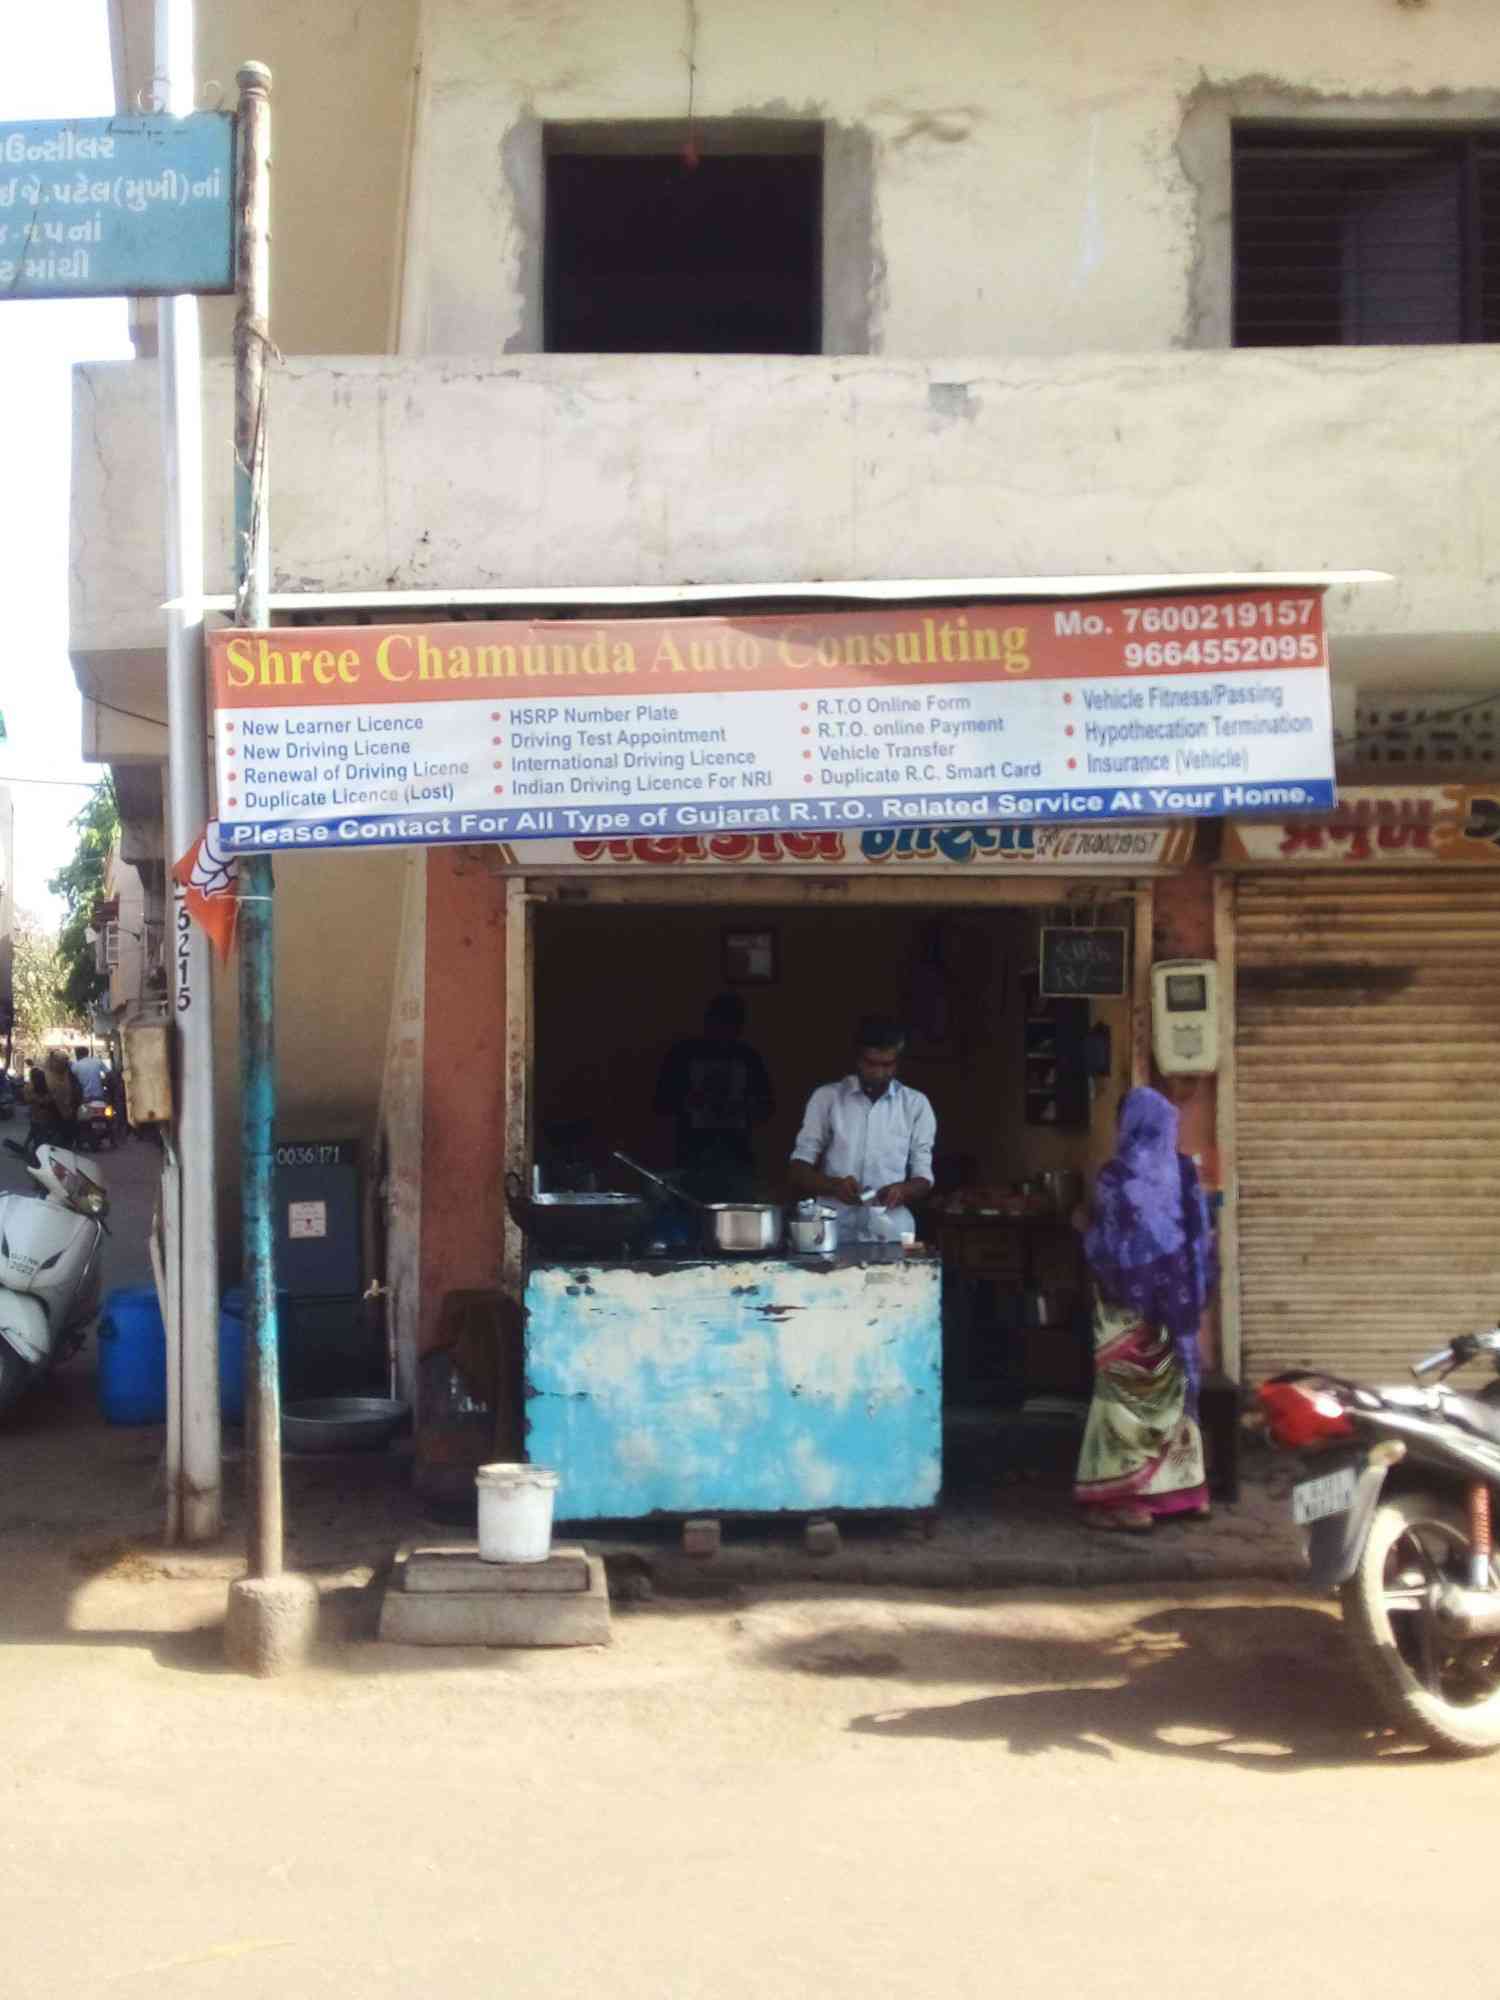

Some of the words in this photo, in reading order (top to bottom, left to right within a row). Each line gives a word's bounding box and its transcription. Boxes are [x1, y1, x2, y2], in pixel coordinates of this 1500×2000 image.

[1054, 610, 1113, 636] Mo.
[1122, 600, 1315, 634] 7600219157
[226, 638, 360, 687] Shree
[376, 632, 635, 682] Chamunda
[650, 629, 762, 673] Auto
[779, 616, 1030, 673] Consulting
[1124, 635, 1318, 668] 9664552095
[867, 697, 920, 713] Online
[927, 695, 971, 712] Form
[1083, 689, 1143, 711] Vehicle
[1150, 683, 1283, 709] Fitness/Passing
[242, 720, 279, 735] New
[285, 720, 351, 734] Learner
[357, 716, 423, 732] Licence
[510, 708, 558, 725] HSRP
[564, 707, 630, 723] Number
[637, 705, 678, 721] Plate
[818, 721, 867, 738] R.T.O.
[874, 719, 924, 736] online
[931, 717, 1004, 736] Payment
[511, 732, 572, 750] Driving
[577, 730, 612, 746] Test
[617, 726, 727, 747] Appointment
[1085, 718, 1208, 746] Hypothecation
[1212, 714, 1313, 737] Termination
[243, 744, 280, 760] New
[286, 741, 348, 761] Driving
[354, 740, 411, 756] Licene
[512, 753, 618, 772] International
[624, 751, 685, 770] Driving
[690, 749, 755, 766] Licence
[819, 745, 880, 761] Vehicle
[886, 741, 955, 759] Transfer
[1088, 753, 1169, 773] Insurance
[1175, 748, 1248, 775] (Vehicle)
[244, 767, 318, 784] Renewal
[324, 767, 340, 780] of
[346, 763, 407, 780] Driving
[413, 761, 469, 777] Licene
[513, 777, 564, 795] Indian
[571, 777, 631, 796] Driving
[637, 773, 702, 791] Licence
[708, 772, 736, 788] For
[742, 771, 772, 787] NRI
[821, 766, 899, 787] Duplicate
[906, 765, 941, 782] R.C.
[946, 762, 995, 779] Smart
[1001, 760, 1041, 778] Card
[245, 791, 326, 810] Duplicate
[333, 788, 398, 804] Licence
[404, 783, 454, 803] (Lost)
[233, 824, 329, 845] Please
[338, 817, 450, 840] Contact
[459, 814, 508, 834] For
[515, 810, 553, 831] All
[562, 810, 629, 831] Type
[640, 808, 668, 826] of
[676, 804, 781, 829] Gujarat
[789, 800, 873, 821] R.T.O.
[882, 798, 987, 818] Related
[998, 789, 1103, 815] Service
[1111, 790, 1144, 811] At
[1151, 787, 1217, 808] Your
[1223, 785, 1314, 806] Home.
